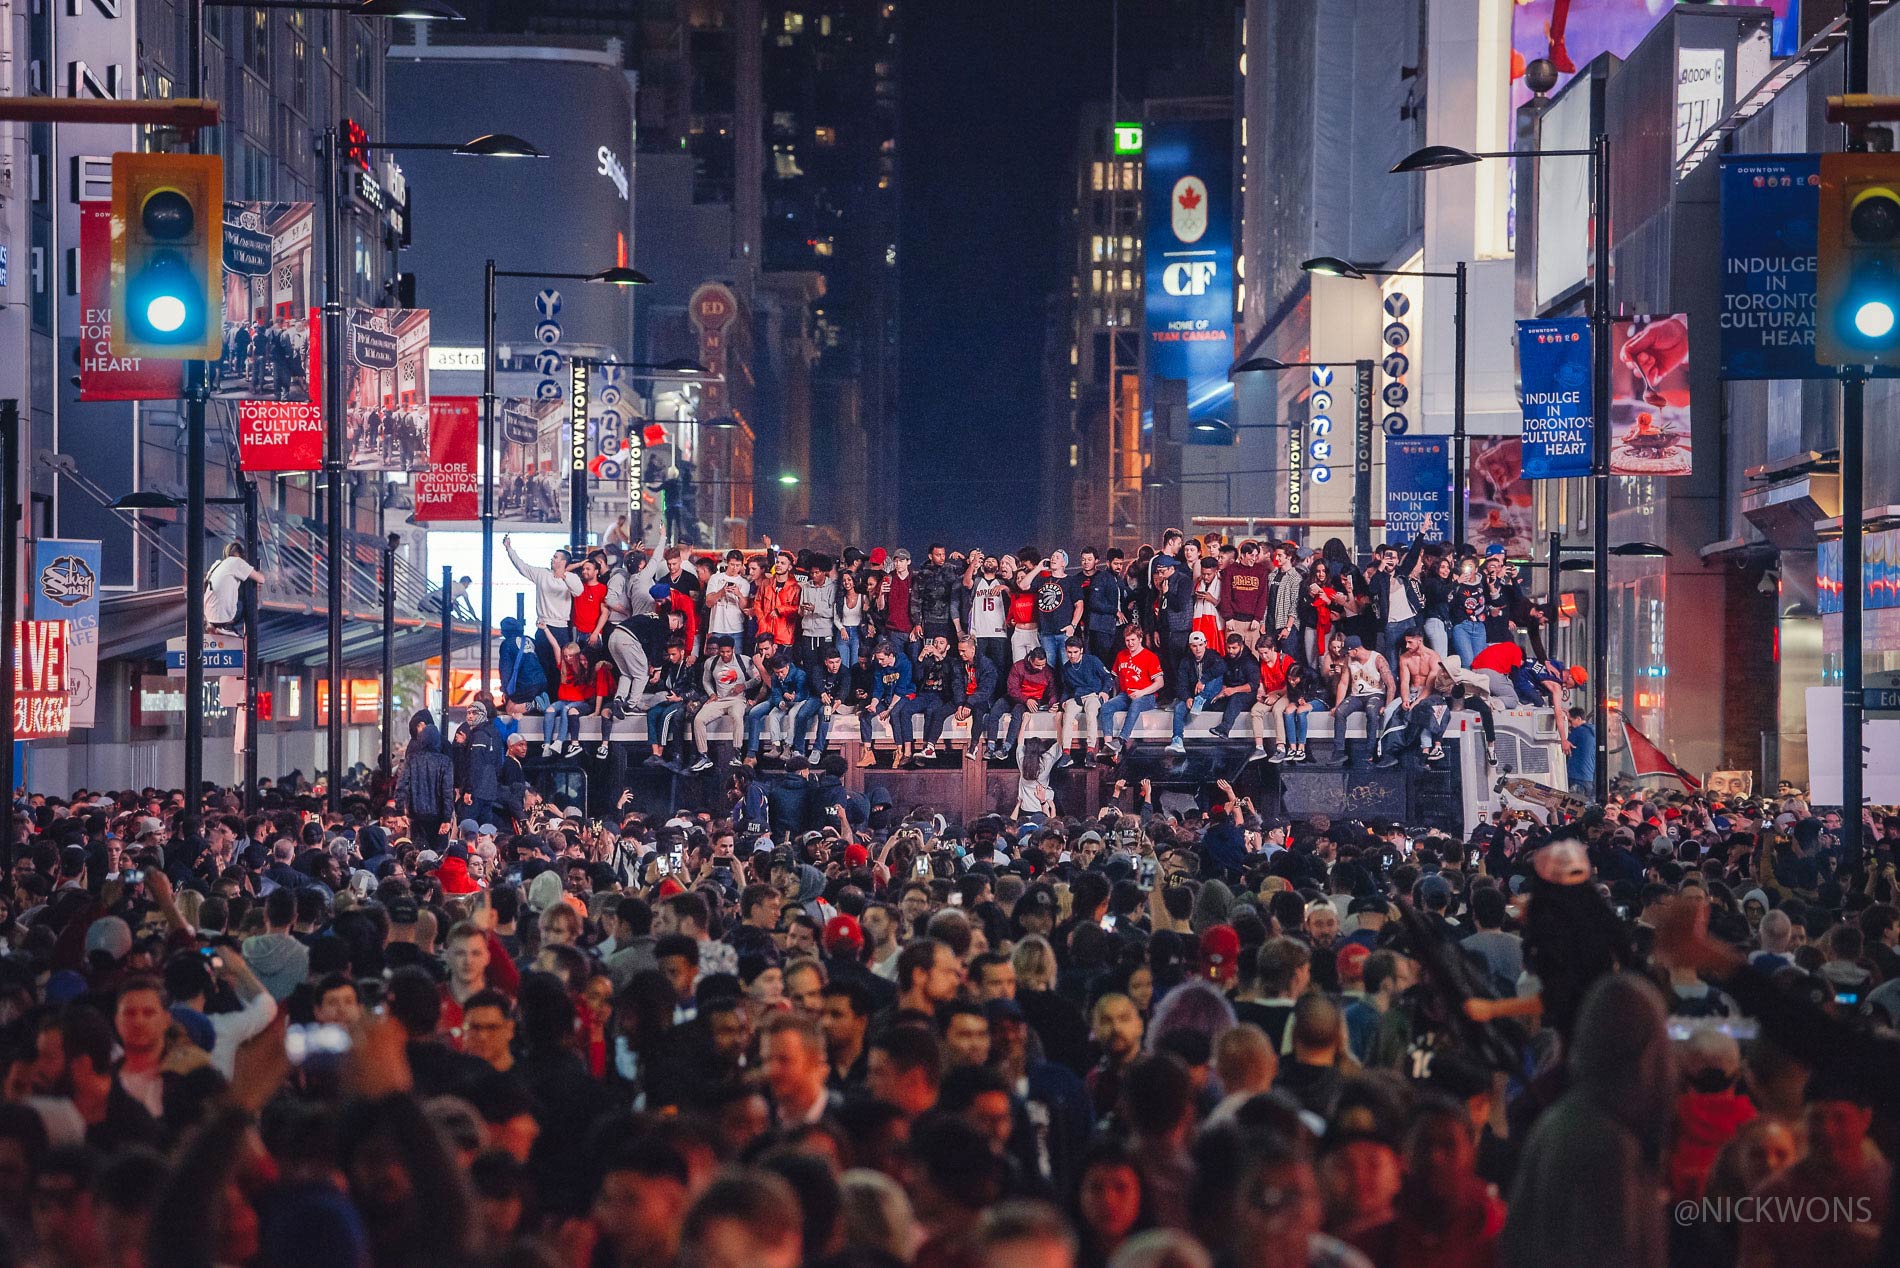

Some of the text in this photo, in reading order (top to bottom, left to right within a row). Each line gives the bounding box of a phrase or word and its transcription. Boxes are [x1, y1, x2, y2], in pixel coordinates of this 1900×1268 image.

[1115, 128, 1143, 150] TD
[1727, 257, 1818, 274] INDULGE
[1162, 261, 1217, 296] CF
[1766, 276, 1787, 291] IN
[1761, 330, 1818, 347] HEAR
[84, 357, 142, 372] HEART
[1526, 392, 1579, 405] INDULGE
[239, 406, 321, 420] TORONTO'S
[1547, 405, 1560, 417] IN
[573, 366, 586, 471] DOWNTOWN
[1310, 365, 1333, 485] Yonge
[1359, 369, 1370, 473] DOWNTOWN
[252, 419, 323, 433] CULTURAL
[243, 432, 291, 446] HEART
[1522, 432, 1582, 443] CULTURAL
[1545, 443, 1586, 455] HEART
[1289, 429, 1300, 515] DOWNTOWN
[416, 493, 454, 504] HEART
[1388, 491, 1439, 502] INDULGE
[1409, 501, 1423, 512] IN
[983, 597, 996, 612] 15
[223, 654, 233, 666] St
[1358, 683, 1365, 695] 2
